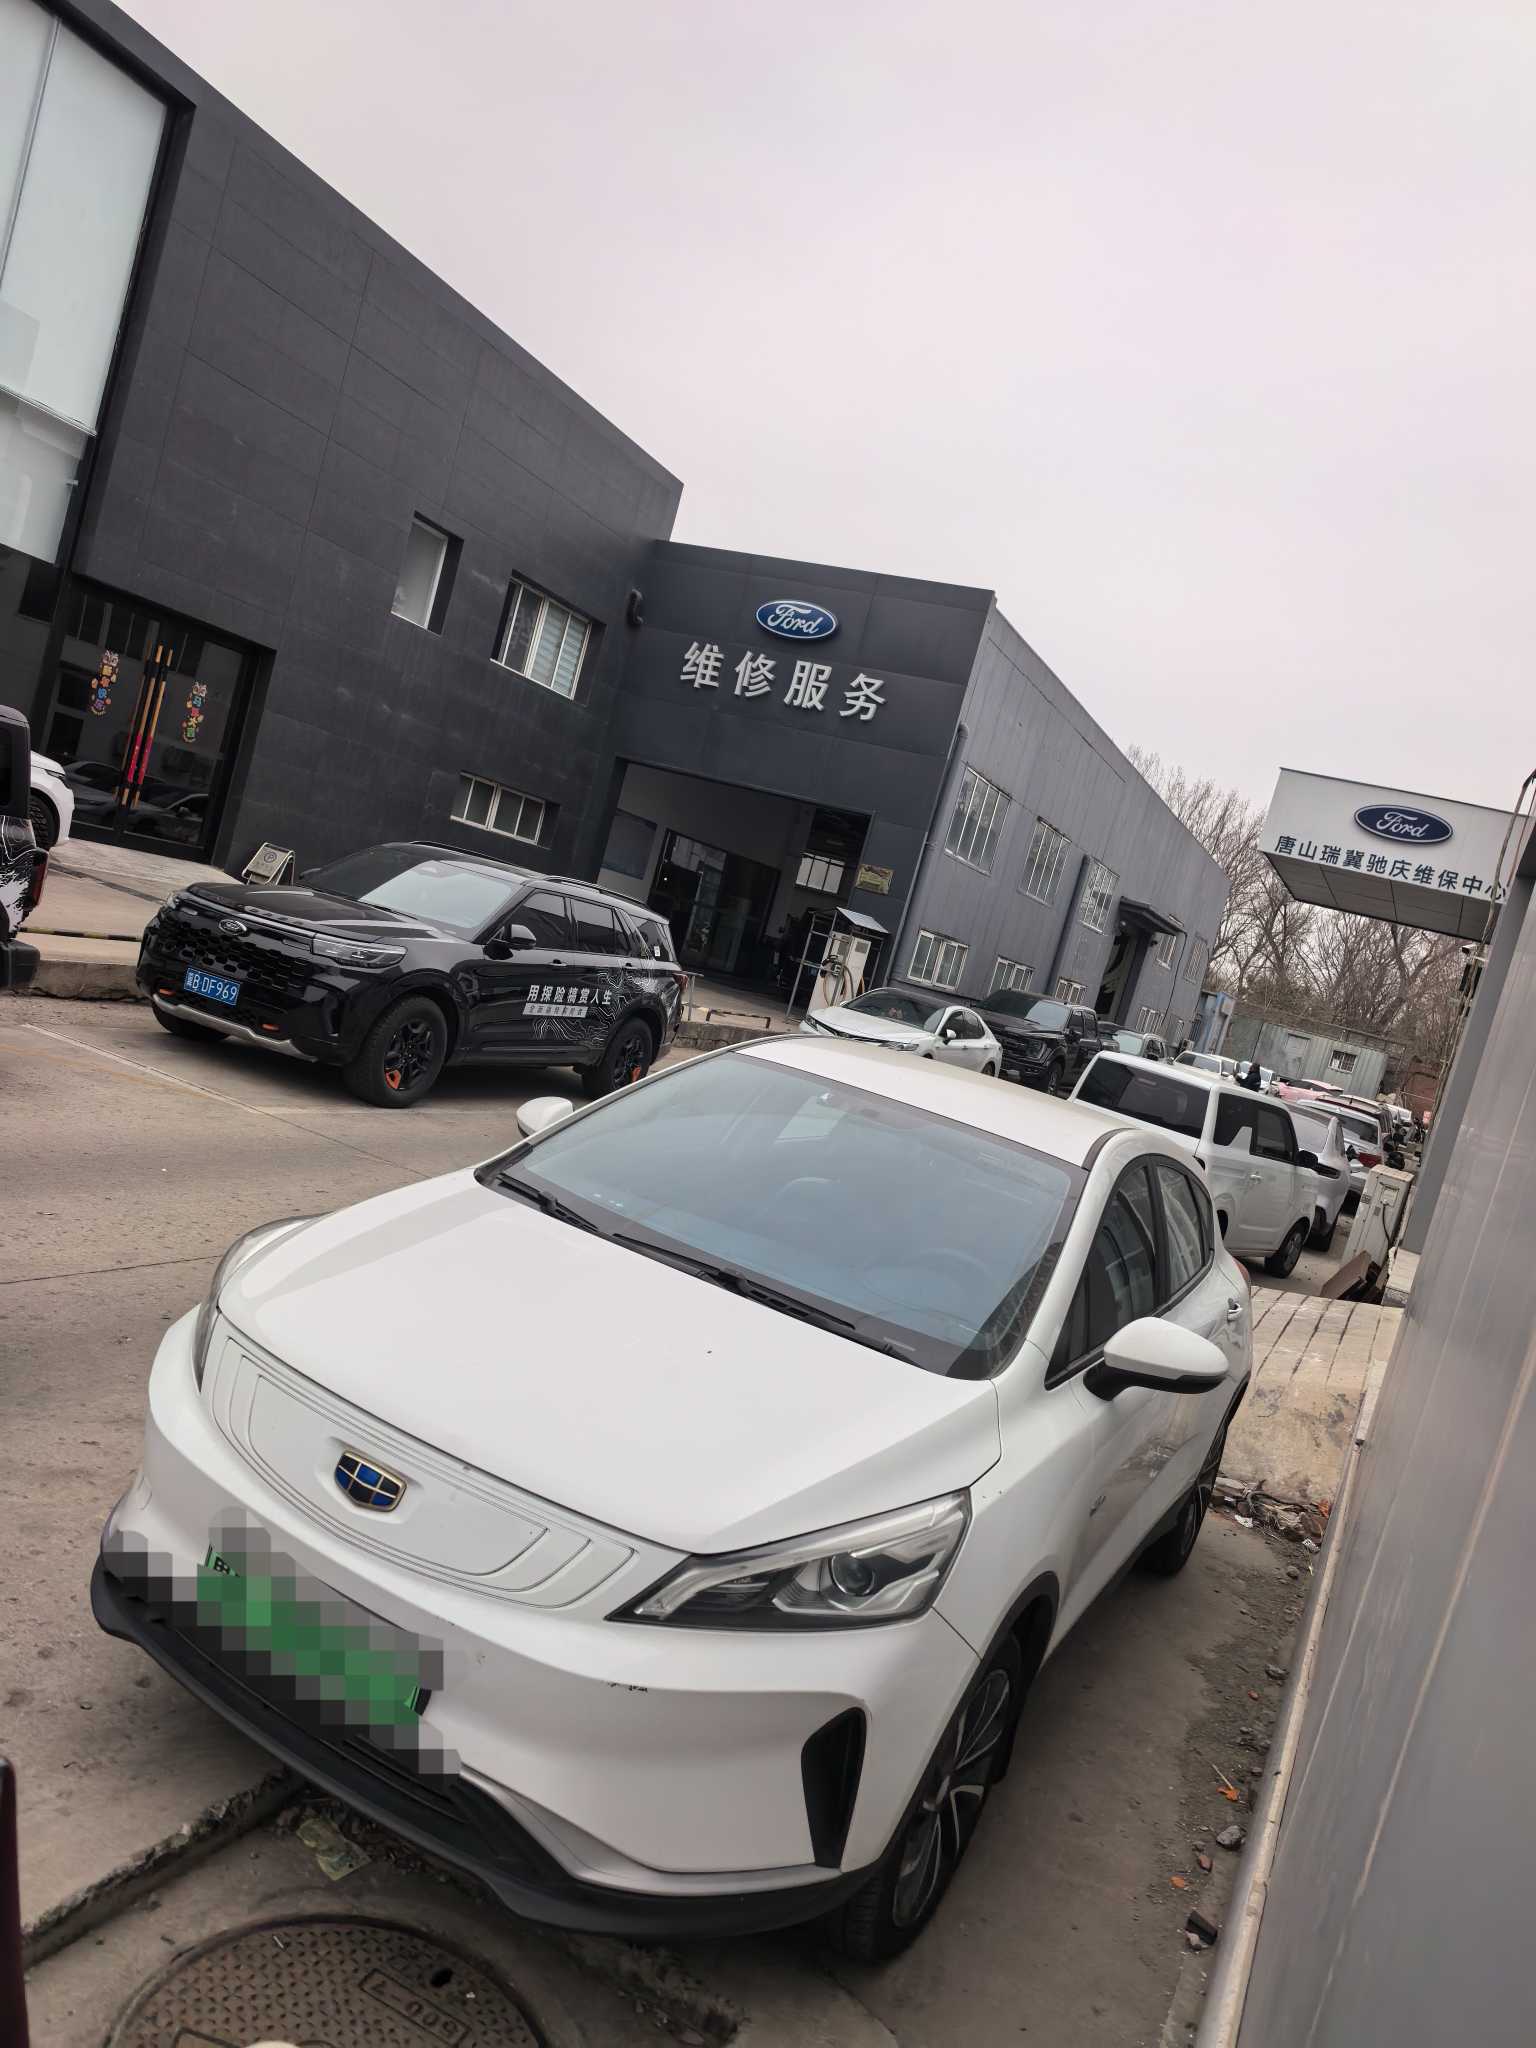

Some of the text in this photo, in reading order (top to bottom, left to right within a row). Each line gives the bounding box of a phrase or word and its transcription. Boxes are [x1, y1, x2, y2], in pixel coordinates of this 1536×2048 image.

[767, 604, 824, 635] Ford
[680, 641, 887, 721] 维修服务
[1375, 811, 1431, 838] Ford
[1274, 836, 1507, 900] 唐山瑞冀驰庆维保中心
